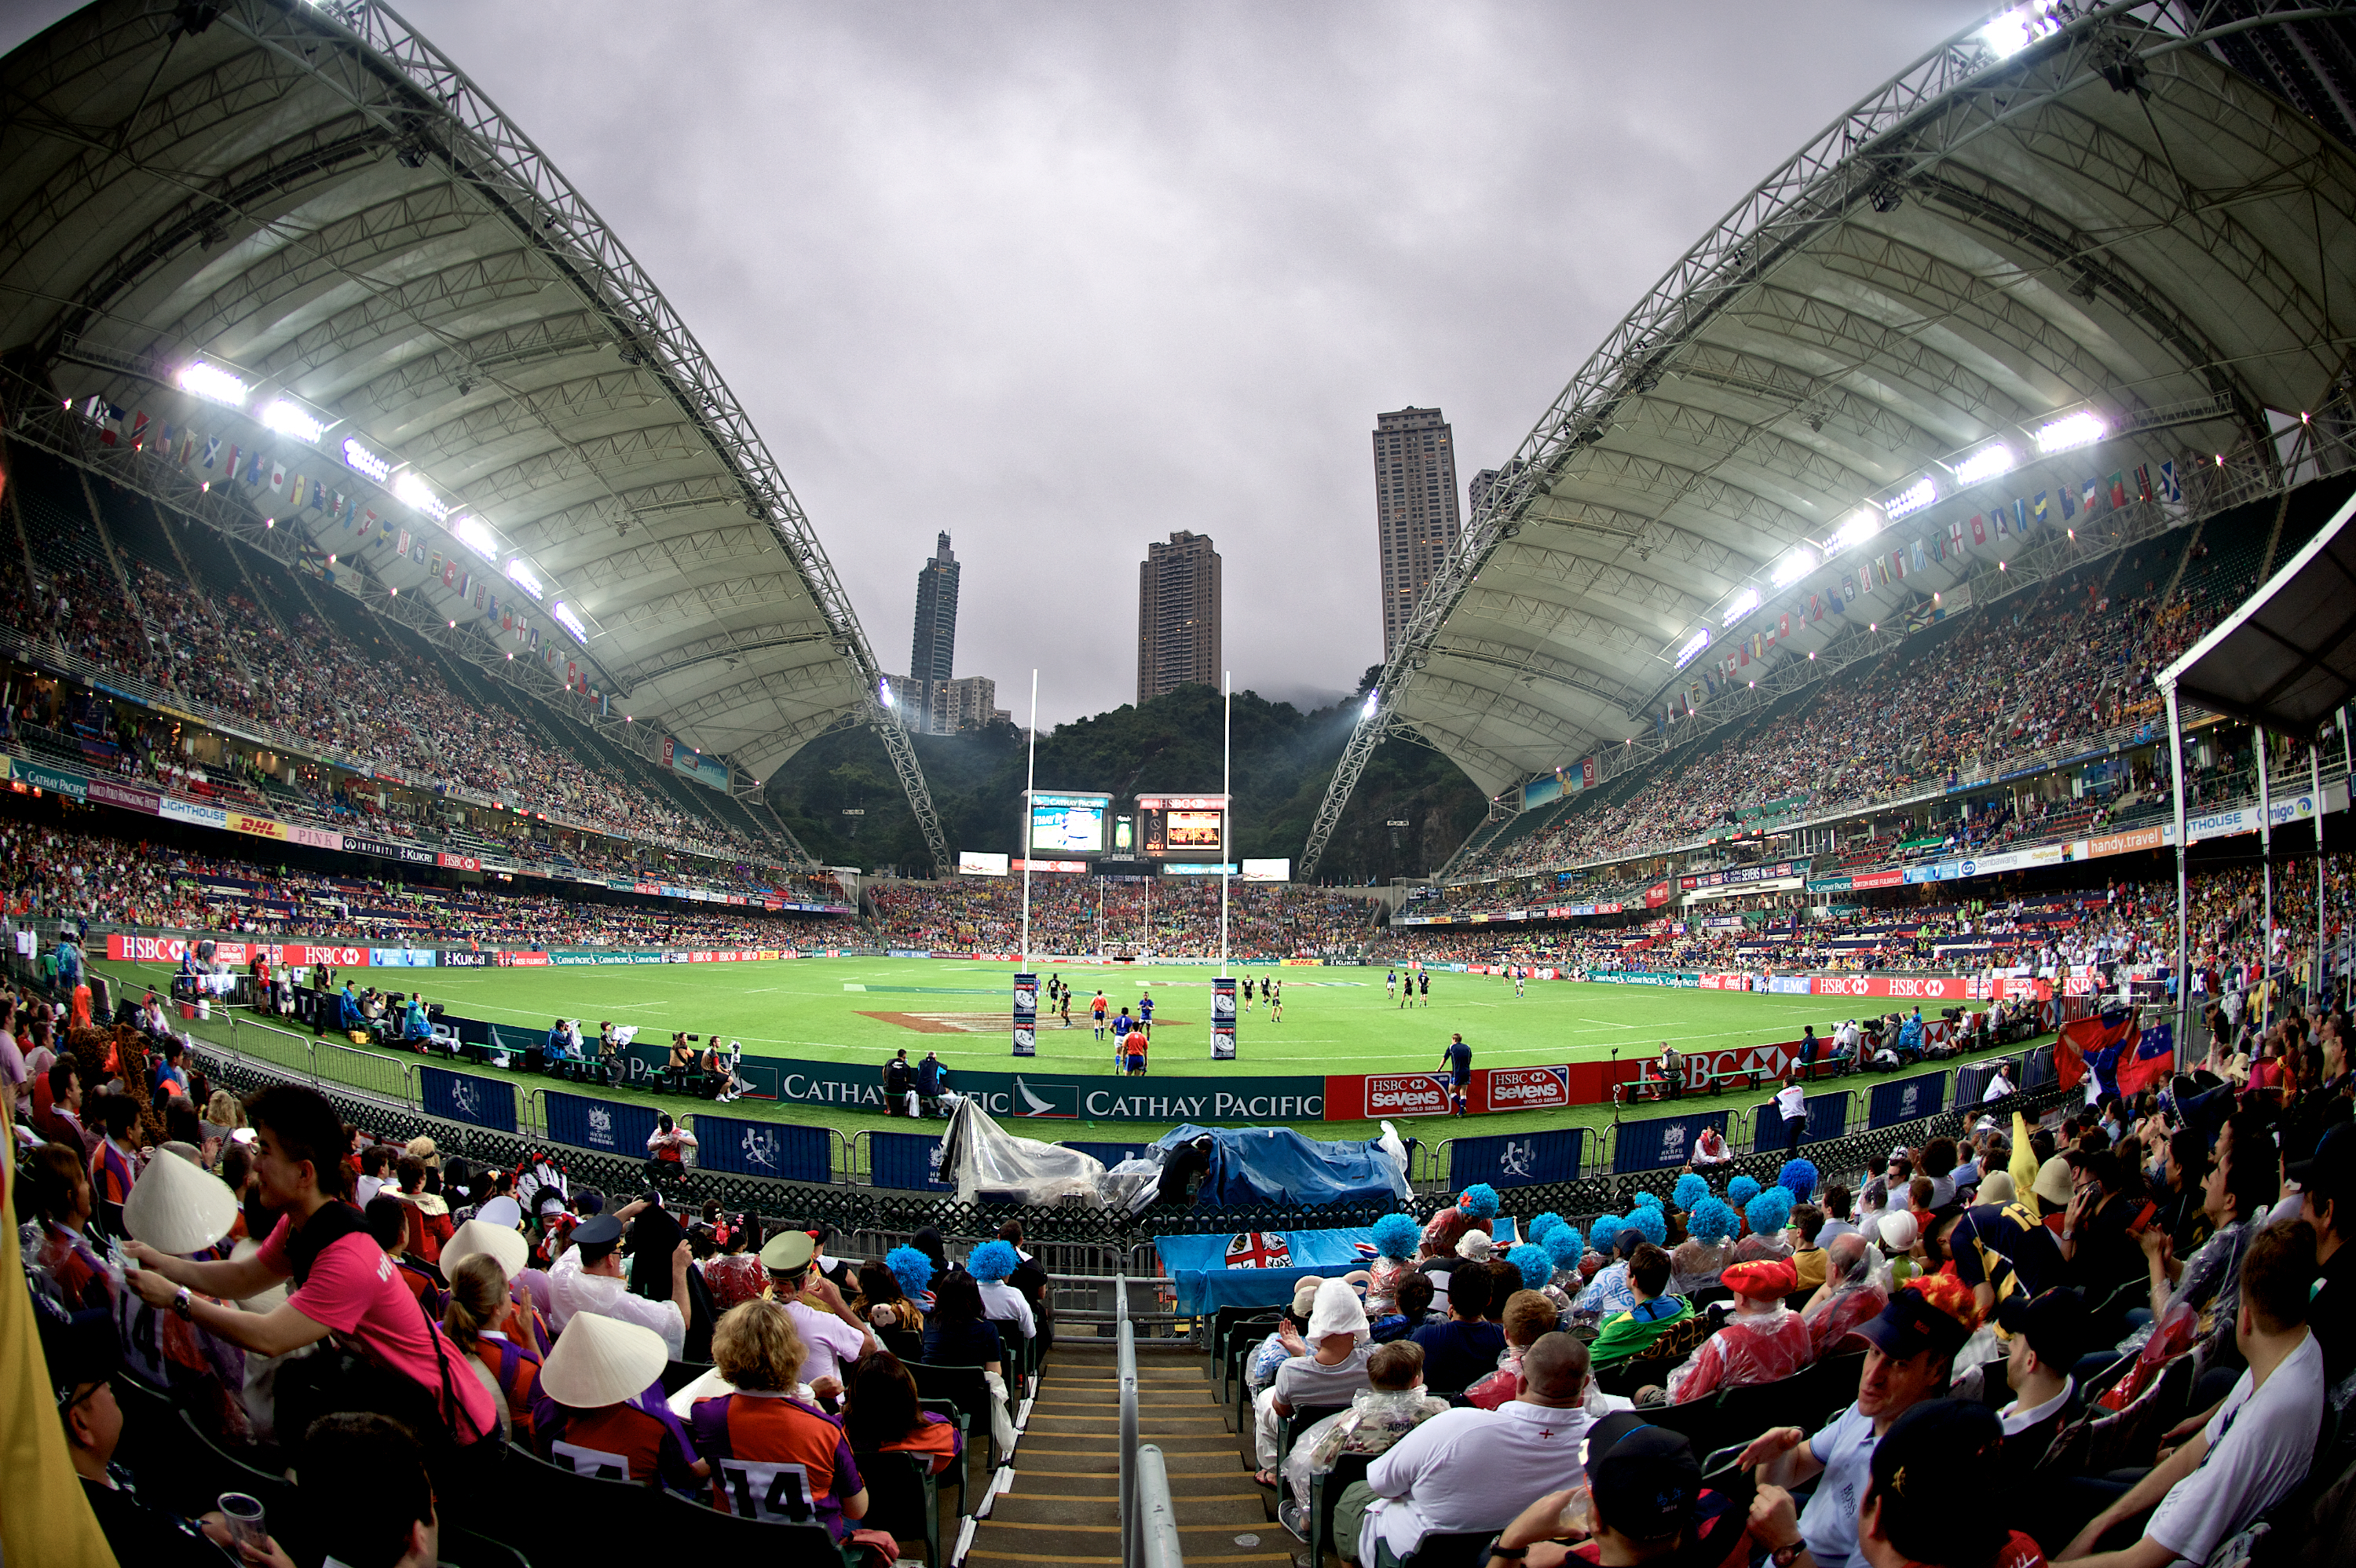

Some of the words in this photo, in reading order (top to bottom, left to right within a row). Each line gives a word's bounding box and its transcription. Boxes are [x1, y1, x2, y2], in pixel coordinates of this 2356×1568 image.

[27, 770, 58, 788] CATHAY
[60, 779, 87, 796] PACIFIC
[89, 783, 106, 797] MARCO
[106, 786, 118, 799] POLO
[118, 789, 144, 807] HONGKONG
[145, 795, 159, 810] HOTEL
[160, 799, 227, 821] LIGHTHOUSE
[1160, 799, 1190, 809] HSBC
[240, 817, 276, 835] DHL
[298, 830, 333, 846] PINK
[2091, 828, 2158, 853] handy.travel
[357, 841, 393, 856] INFINITI
[2032, 850, 2059, 860] California
[407, 849, 433, 863] KUKRI
[444, 854, 464, 868] HSBC
[1977, 855, 2018, 868] Sembawang
[1741, 868, 1760, 882] SEVENS
[1879, 876, 1903, 885] FULBRIGHT
[1816, 883, 1834, 892] CATHAY
[1598, 905, 1611, 913] HSBC
[122, 936, 167, 960] HSBC
[384, 949, 401, 958] TELSTRA
[415, 949, 431, 958] TELSTRA
[305, 947, 341, 965] HSBC
[693, 952, 706, 961] HSBC
[719, 952, 730, 961] HSBC
[742, 952, 752, 960] HSBC
[1642, 976, 1658, 985] PACIFIC
[1683, 978, 1699, 987] PACIFIC
[1820, 978, 1851, 994] HSBC
[1889, 979, 1924, 996] HSBC
[1373, 1079, 1407, 1092] HSBC
[1495, 1073, 1527, 1085] HSBC
[1085, 1091, 1208, 1117] CATHAY
[1215, 1092, 1323, 1117] PACIFIC
[2000, 1202, 2043, 1232] 13
[120, 1288, 162, 1373] 14
[1387, 1422, 1417, 1432] ARMY
[723, 1467, 816, 1522] 14
[1843, 1482, 1857, 1516] BOSS
[1661, 1504, 1677, 1513] 2014
